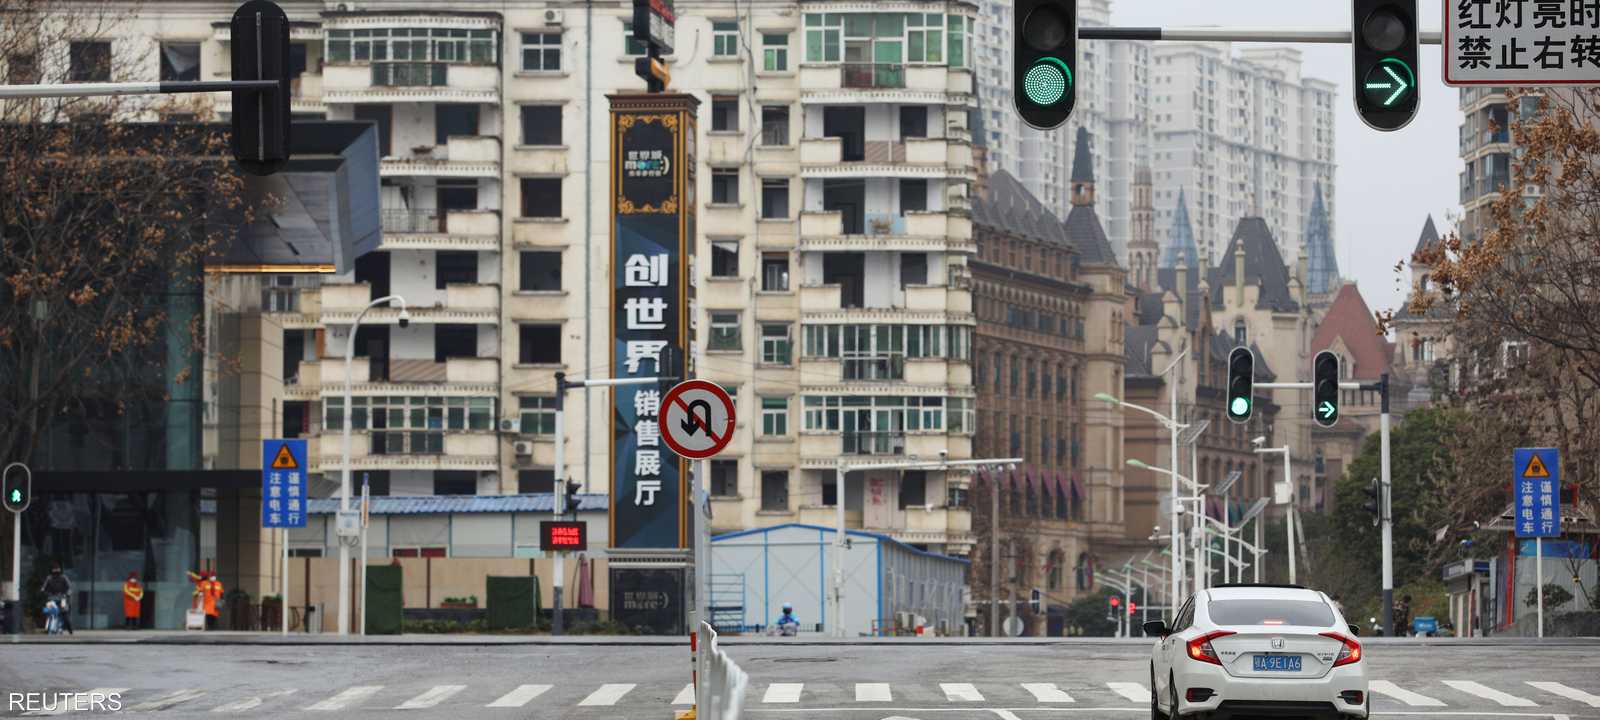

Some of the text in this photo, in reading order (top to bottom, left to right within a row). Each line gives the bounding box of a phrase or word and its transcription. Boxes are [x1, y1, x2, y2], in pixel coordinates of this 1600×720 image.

[1458, 0, 1600, 29] 红灯亮时
[1458, 35, 1600, 70] 禁止右转
[624, 253, 668, 373] 创世界
[634, 389, 662, 506] 销售展厅
[269, 472, 281, 524] 注意电车
[1522, 481, 1534, 533] 注意电车
[1540, 481, 1553, 533] 谨慎通行
